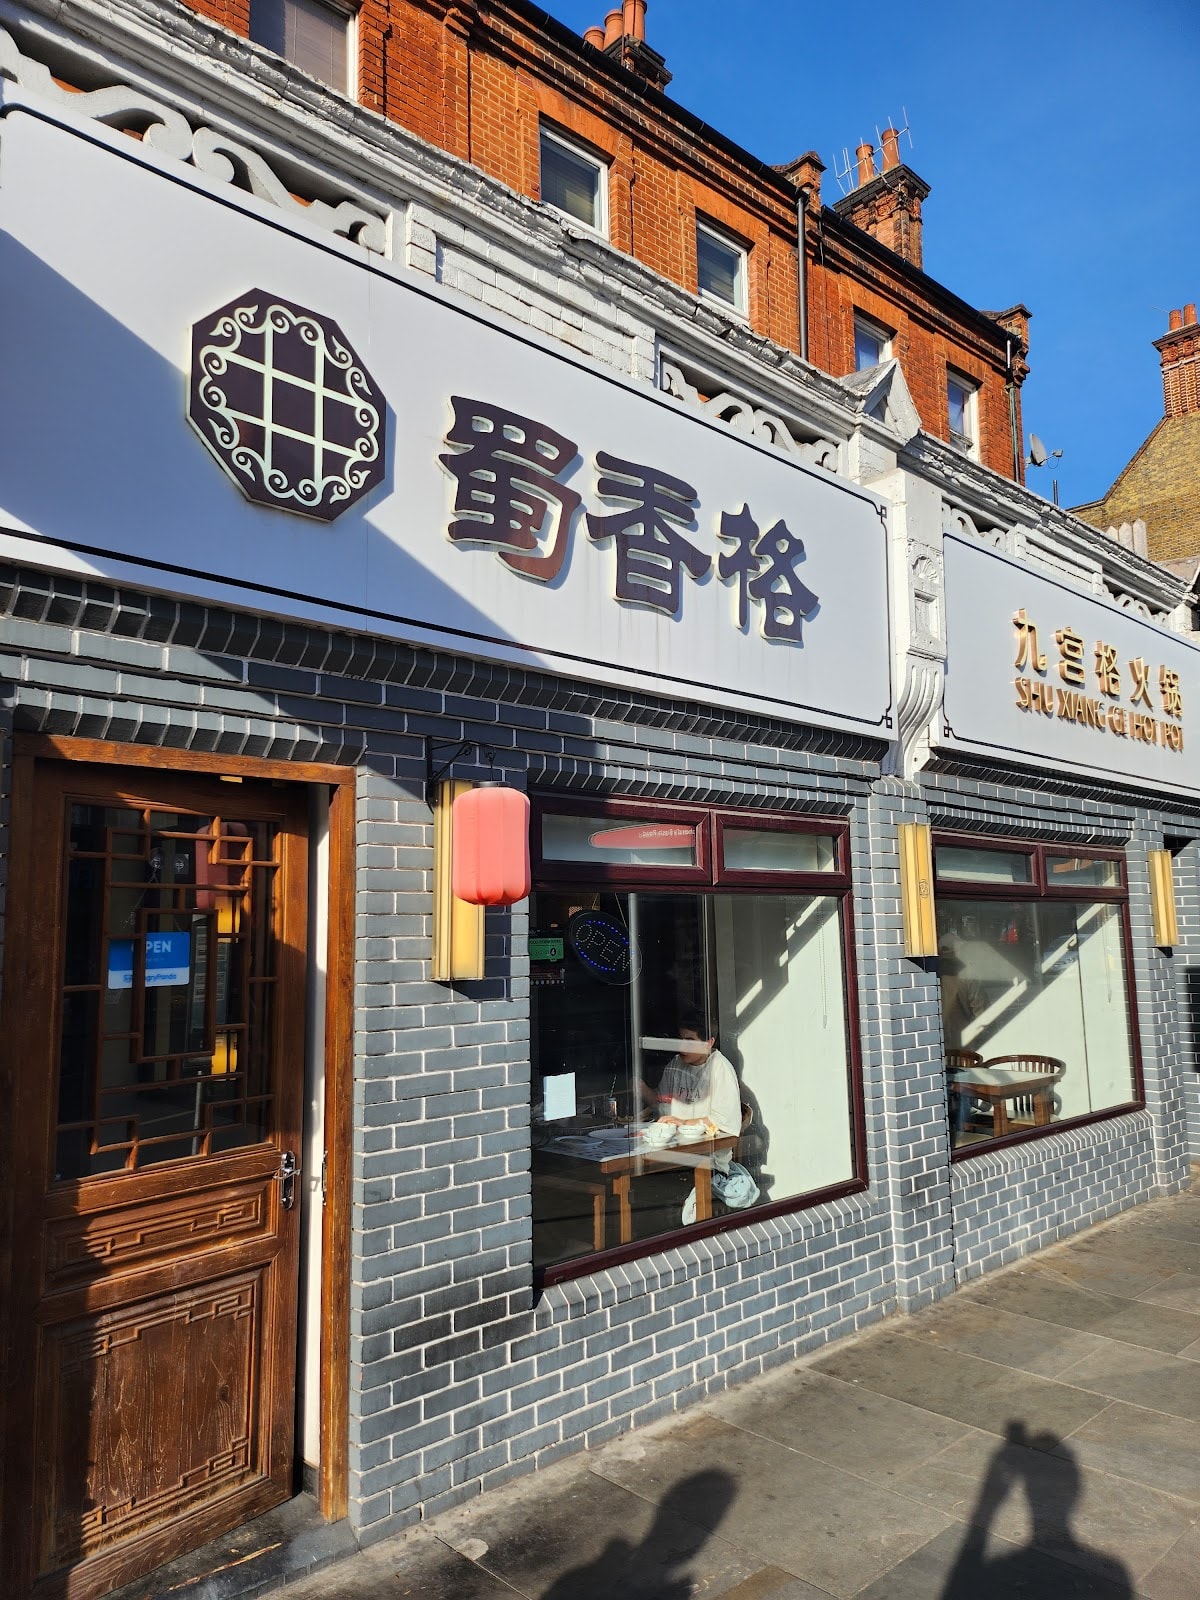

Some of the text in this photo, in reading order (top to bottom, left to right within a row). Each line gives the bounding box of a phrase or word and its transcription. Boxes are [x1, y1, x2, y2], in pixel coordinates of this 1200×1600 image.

[436, 395, 820, 643] 蜀香格
[1012, 608, 1183, 717] 九宫格火锅
[1015, 677, 1054, 713] SHU
[1056, 688, 1106, 728] XIANG
[1128, 711, 1158, 745] HOT
[1160, 721, 1185, 752] POT
[131, 940, 172, 954] PEN
[576, 924, 632, 972] OPEN
